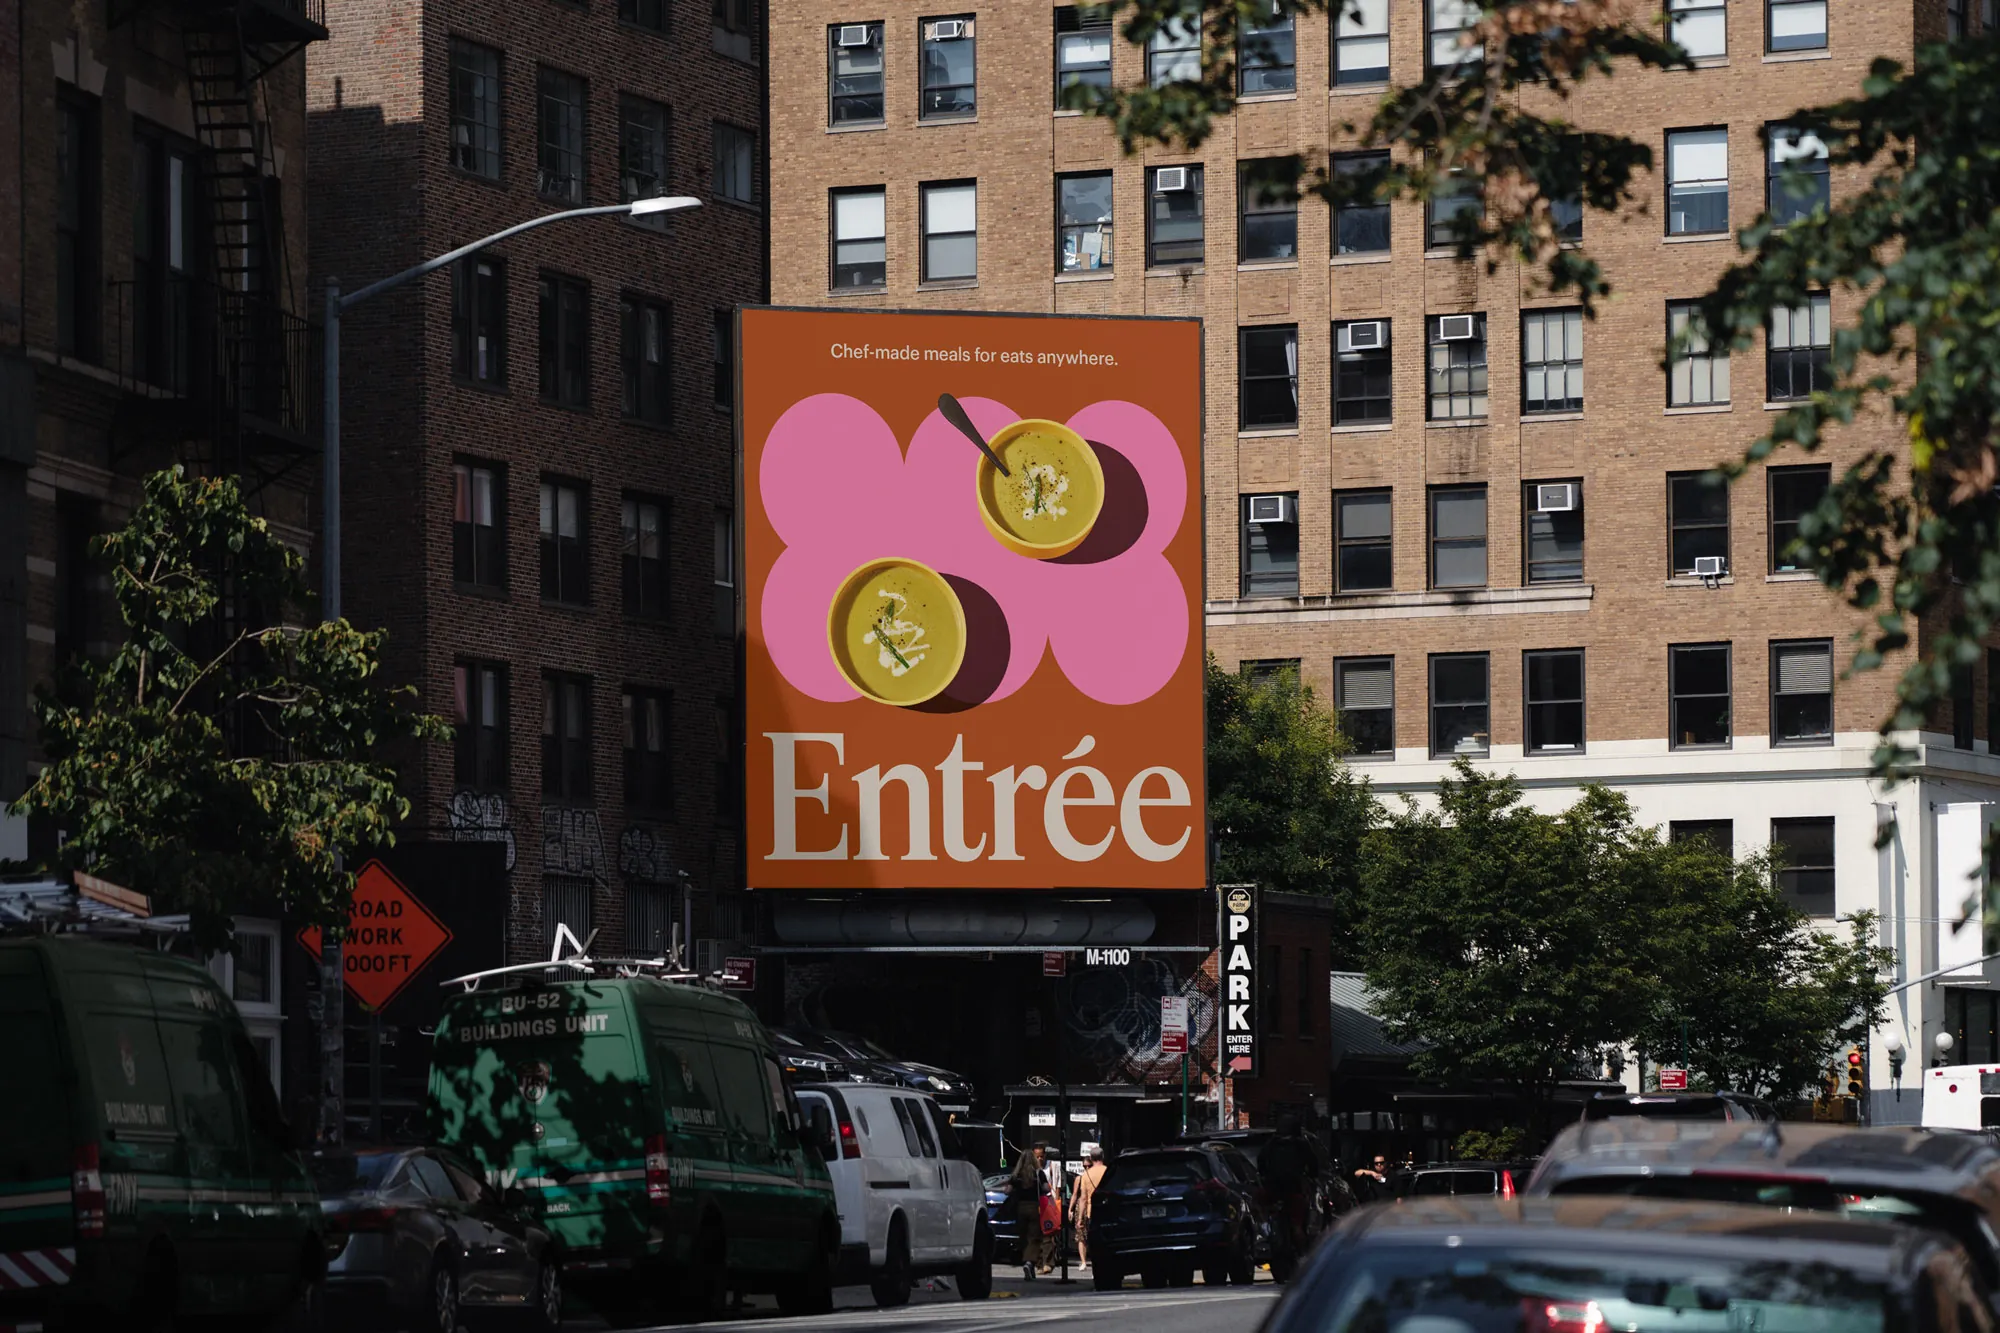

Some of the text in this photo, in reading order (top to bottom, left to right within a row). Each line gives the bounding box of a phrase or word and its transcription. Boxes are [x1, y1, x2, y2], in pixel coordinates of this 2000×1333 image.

[830, 343, 1119, 366] Chef-made meals for eats anywhere.
[762, 732, 1192, 862] Entrée
[346, 900, 403, 918] ROAD
[345, 928, 403, 945] WORK
[1086, 948, 1130, 966] M-1100
[1227, 914, 1252, 1031] PARK
[460, 1014, 609, 1043] BUILDINGS UNIT
[1226, 1034, 1253, 1044] ENTER
[1228, 1044, 1251, 1054] HERE
